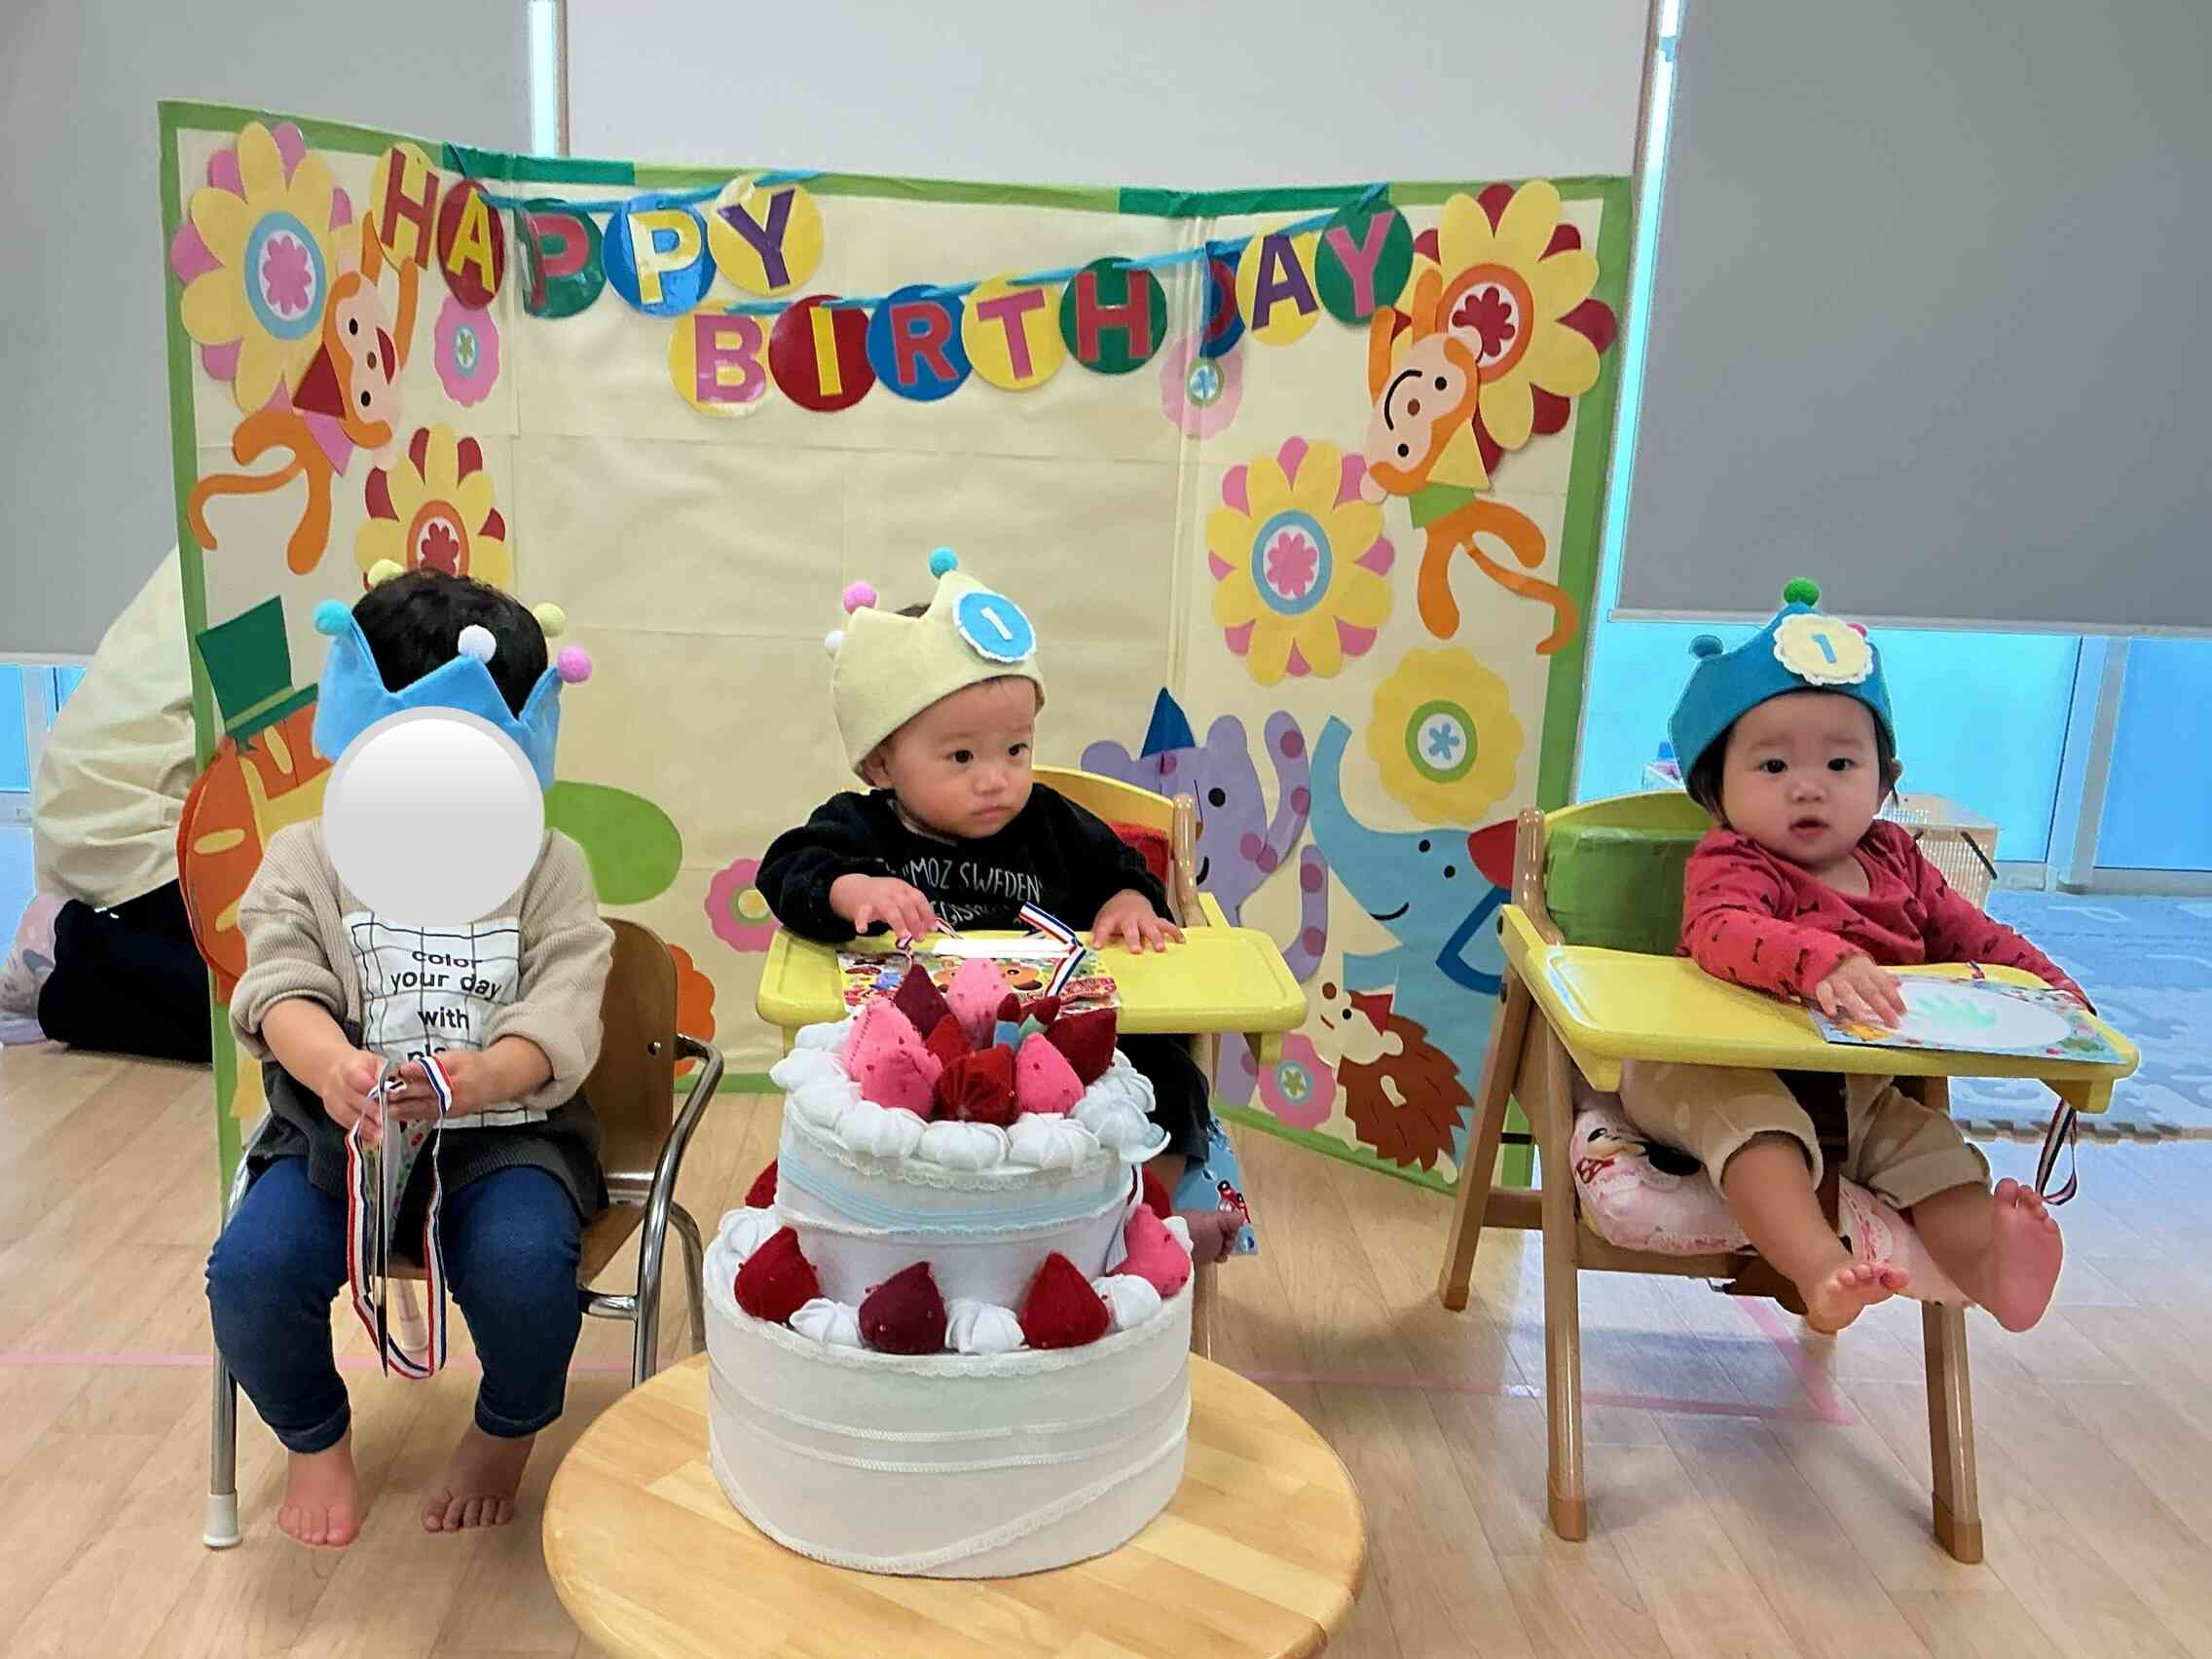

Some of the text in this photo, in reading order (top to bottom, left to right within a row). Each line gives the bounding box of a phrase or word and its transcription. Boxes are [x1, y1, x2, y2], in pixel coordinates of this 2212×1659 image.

[381, 147, 796, 308] HAPPY
[693, 210, 1395, 404] BIRTHDAY
[980, 607, 1014, 640] 1
[1812, 634, 1837, 664] 1
[411, 950, 483, 970] color
[390, 972, 501, 1001] your day
[417, 1006, 469, 1031] with
